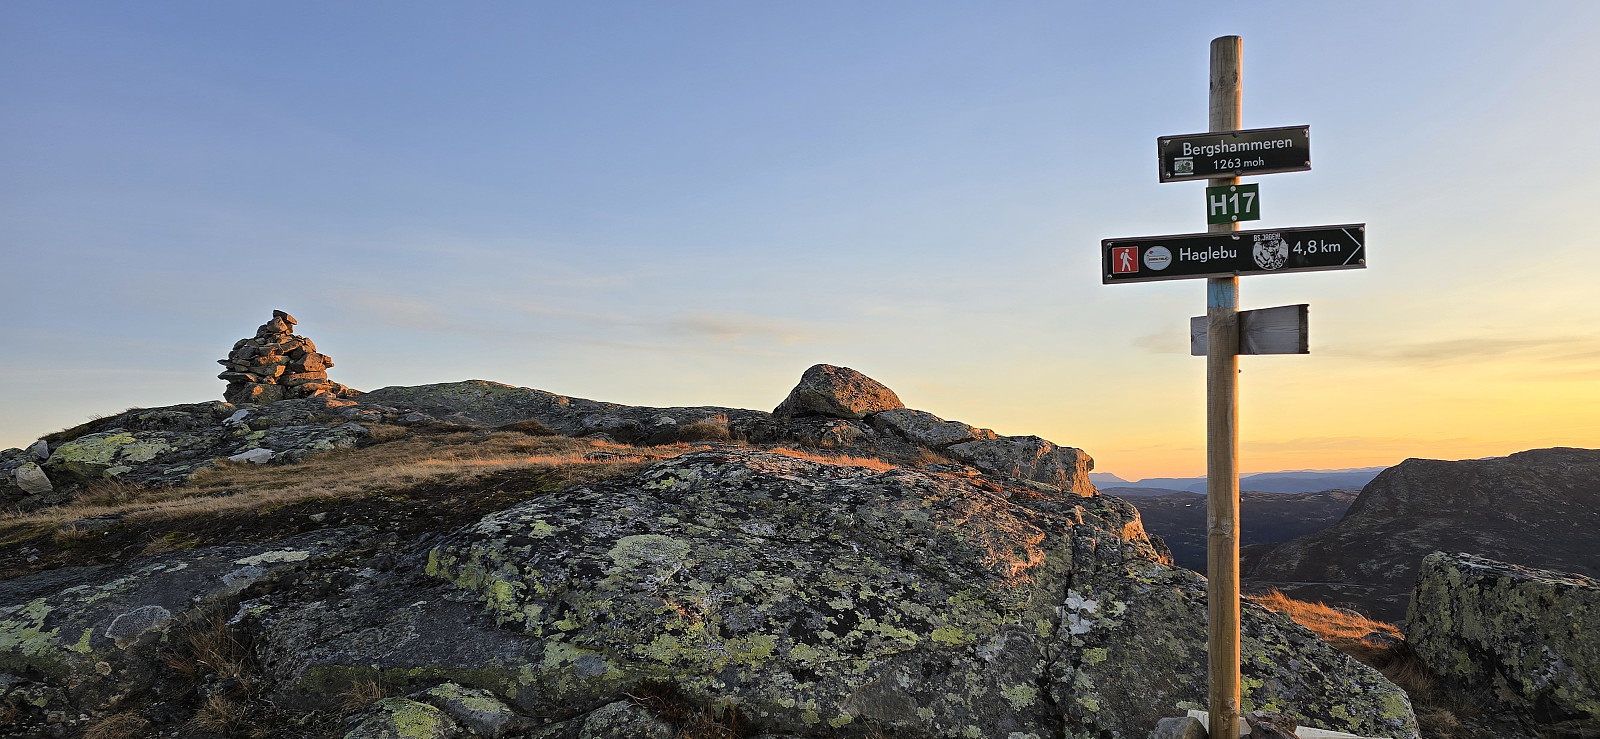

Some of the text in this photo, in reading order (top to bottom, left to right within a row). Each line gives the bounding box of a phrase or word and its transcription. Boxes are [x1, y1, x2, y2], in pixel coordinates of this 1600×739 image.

[1183, 137, 1293, 158] Bergshammeren
[1213, 157, 1265, 170] 1263 moh
[1210, 192, 1256, 215] H17
[1179, 240, 1341, 263] Haglebu 4,8 km
